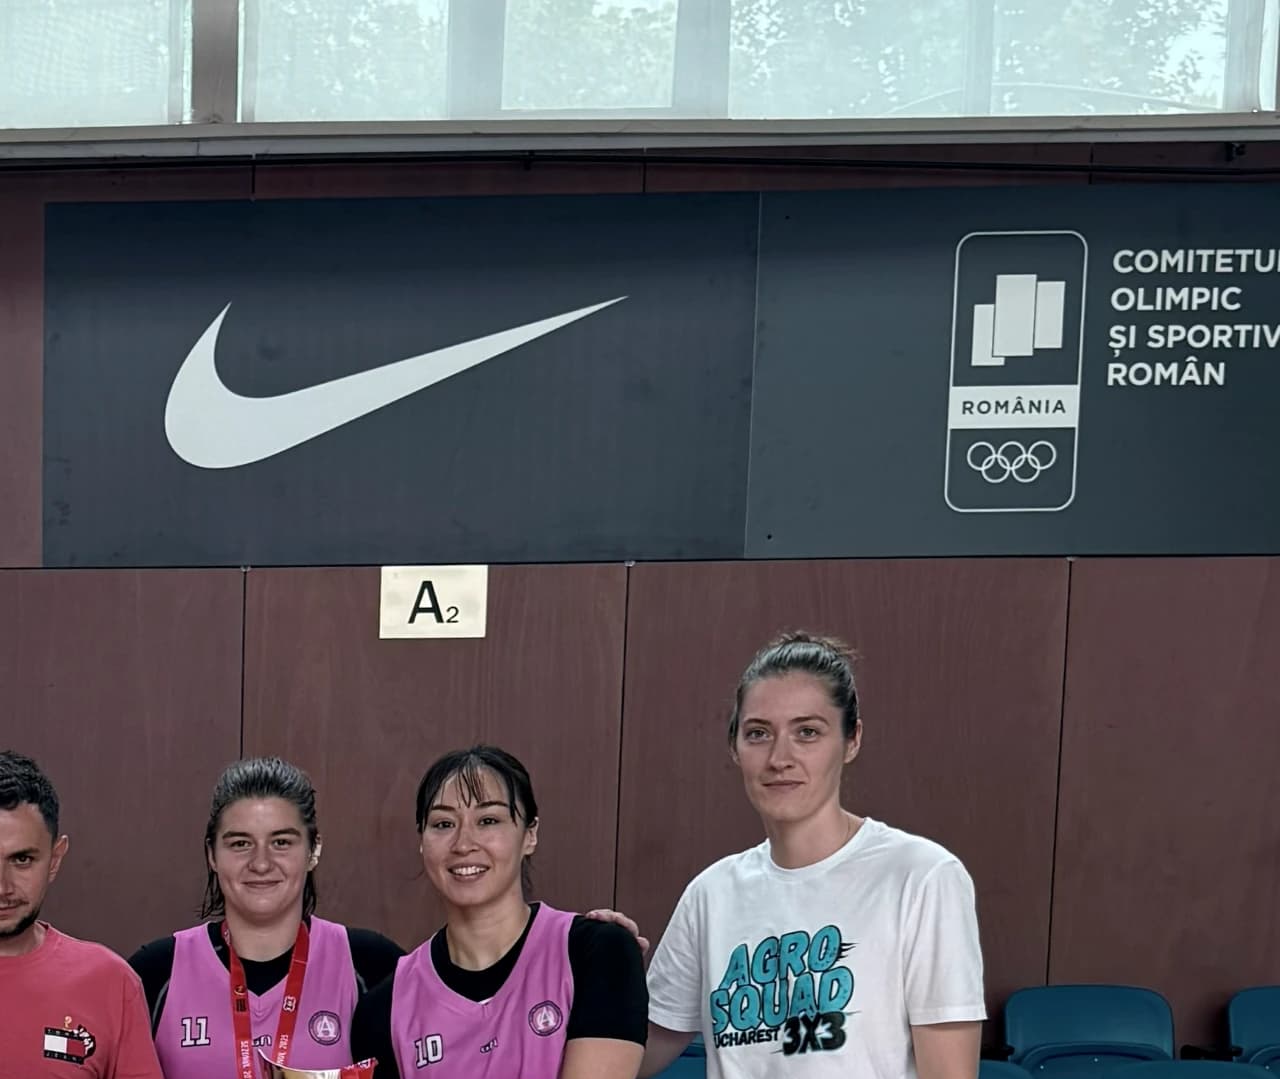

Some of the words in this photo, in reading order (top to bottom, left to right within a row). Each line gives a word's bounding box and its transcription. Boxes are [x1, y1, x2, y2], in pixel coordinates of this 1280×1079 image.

[1112, 248, 1280, 273] COMITETU
[1110, 286, 1242, 311] OLIMPIC
[1108, 324, 1136, 357] ȘI
[1147, 324, 1280, 348] SPORTIV
[1107, 355, 1225, 387] ROMÂN
[961, 396, 1066, 415] ROMÂNIA
[719, 924, 842, 991] AGRO
[709, 965, 855, 1034] SQUAD
[181, 1015, 211, 1047] 11
[714, 1026, 781, 1049] UCHAREST
[782, 1011, 847, 1057] 3X3
[414, 1034, 443, 1068] 10
